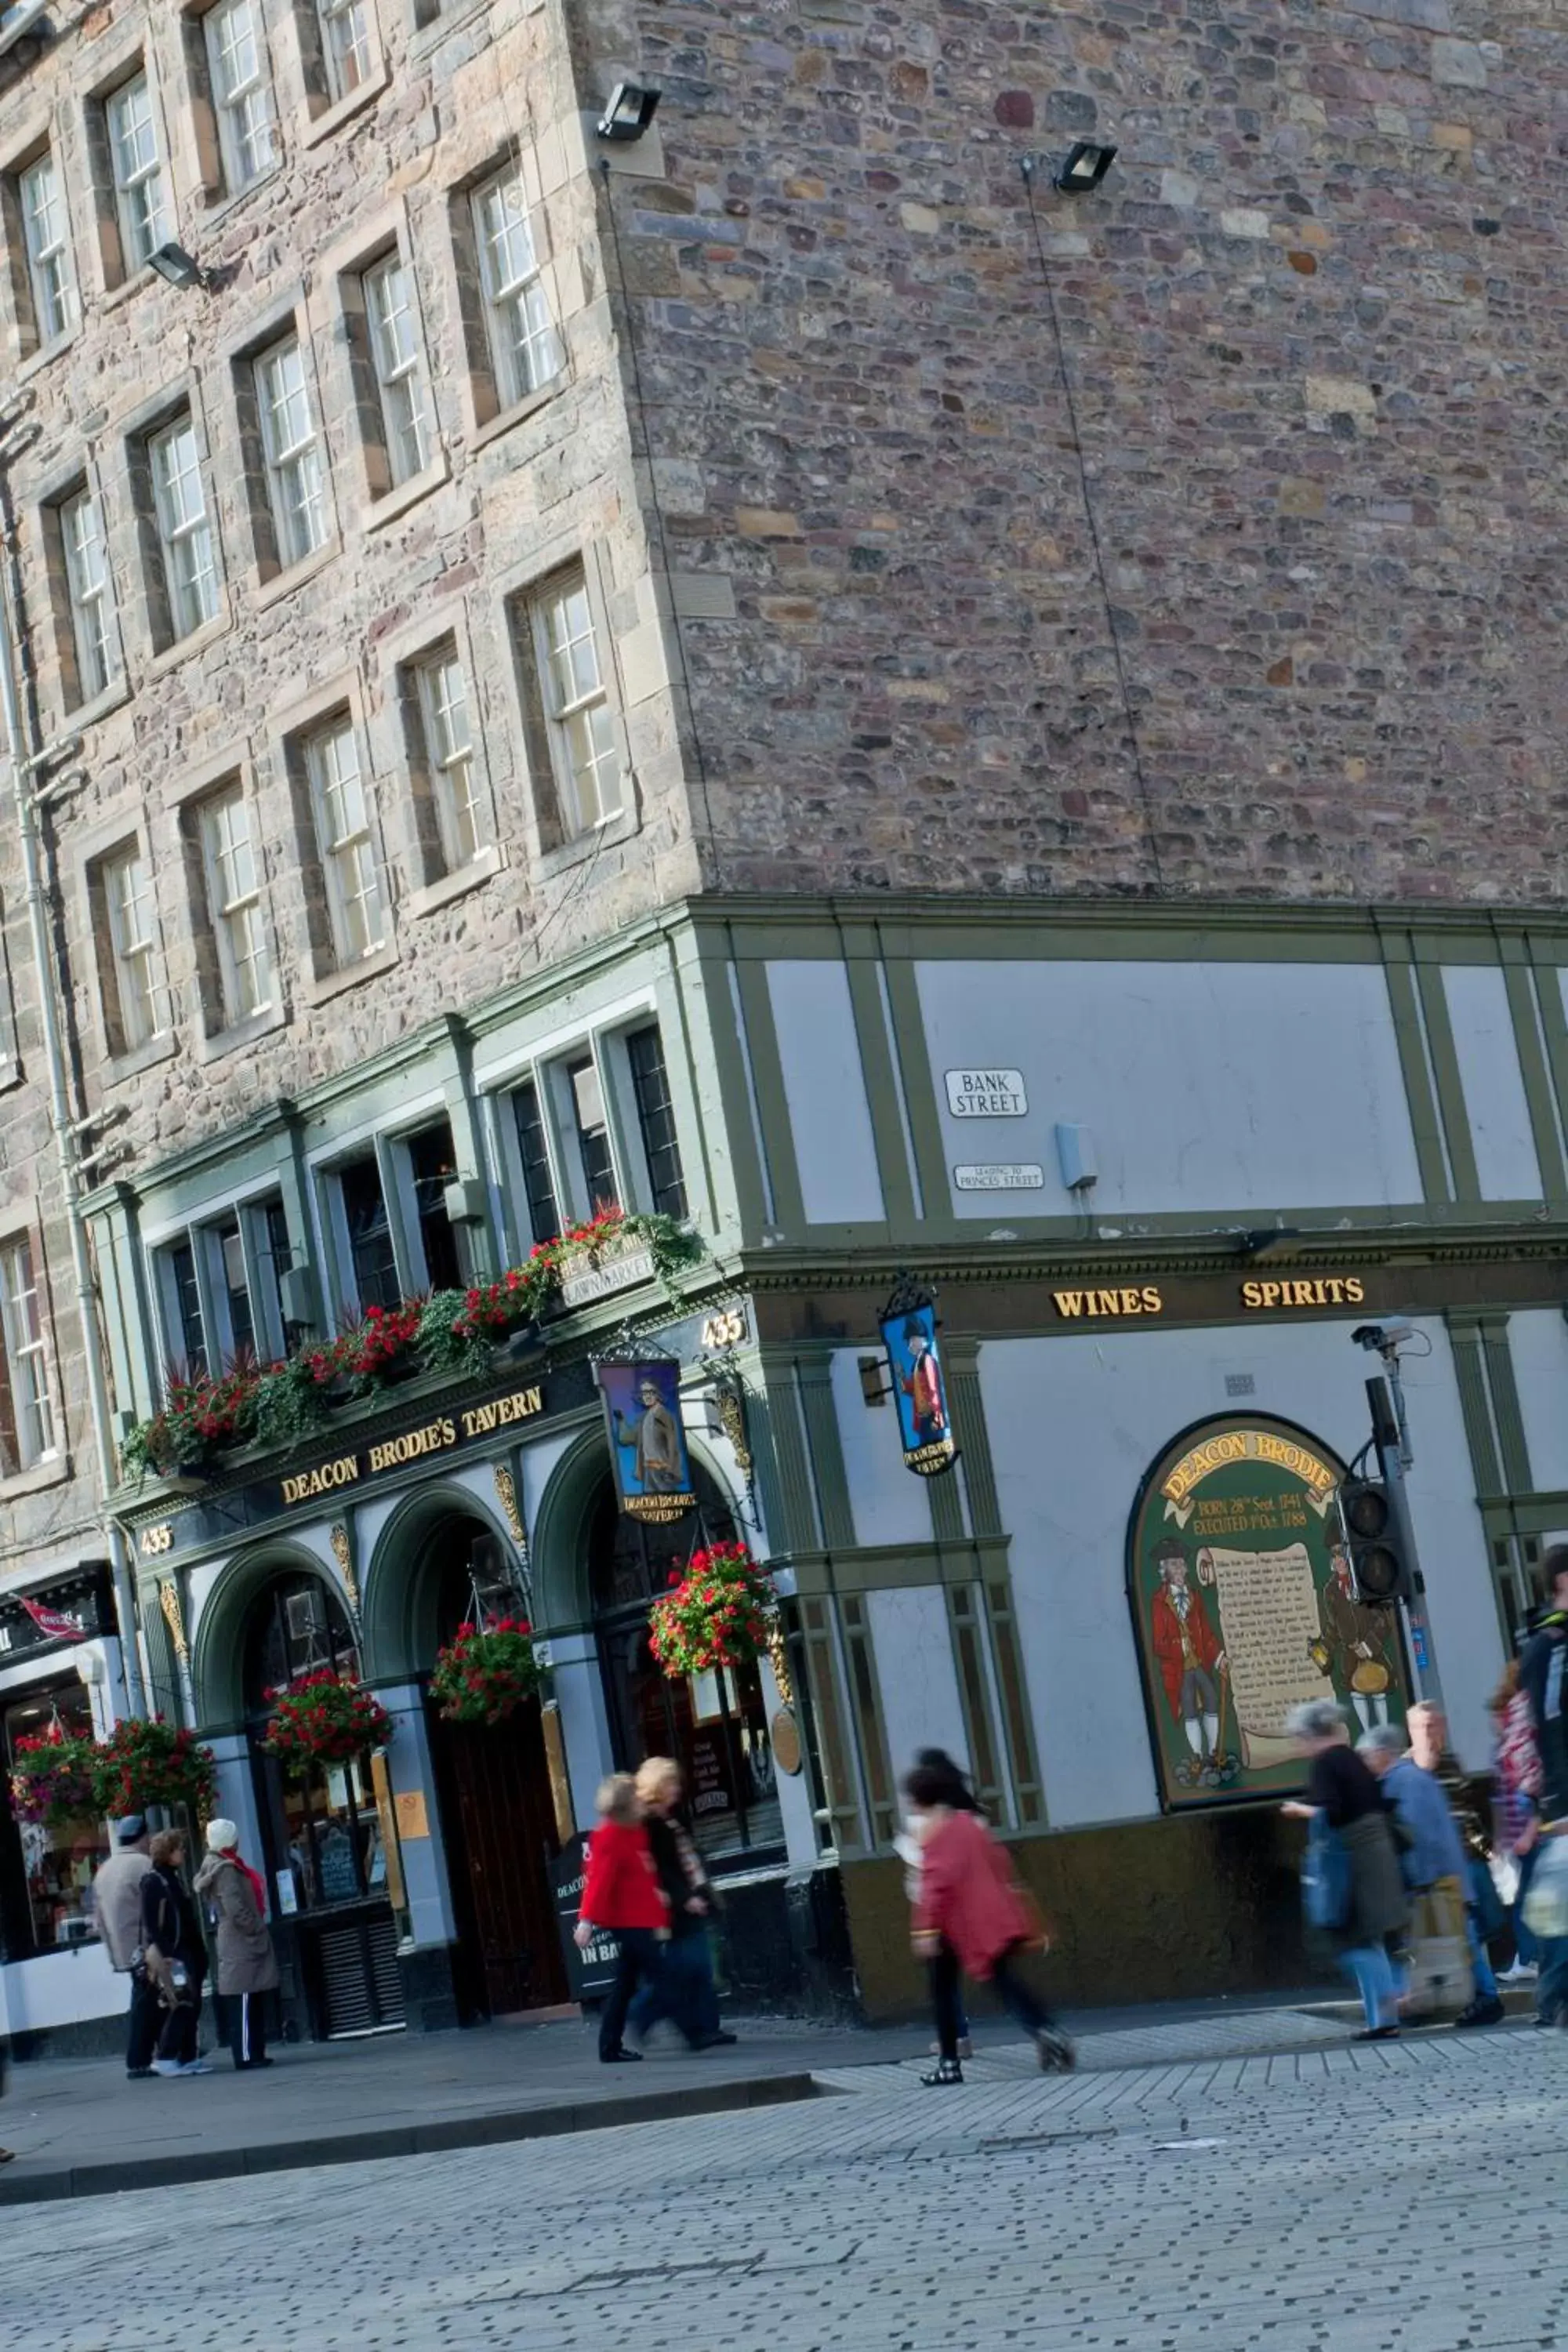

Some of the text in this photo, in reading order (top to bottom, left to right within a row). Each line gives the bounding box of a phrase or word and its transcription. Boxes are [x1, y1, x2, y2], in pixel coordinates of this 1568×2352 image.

[962, 1075, 1010, 1092] BANK
[957, 1094, 1020, 1112] STREET
[1004, 1175, 1039, 1185] STREET
[565, 1256, 652, 1303] LAWNMARKET
[1053, 1278, 1364, 1317] WINES SPIRITS
[702, 1310, 743, 1348] 435
[281, 1386, 543, 1504] DEACON BRODIE'S TAVERN
[1165, 1434, 1331, 1499] DEACON BRODIE
[142, 1523, 172, 1555] 435
[1193, 1516, 1247, 1536] EXECUTED
[580, 1946, 597, 1965] IN
